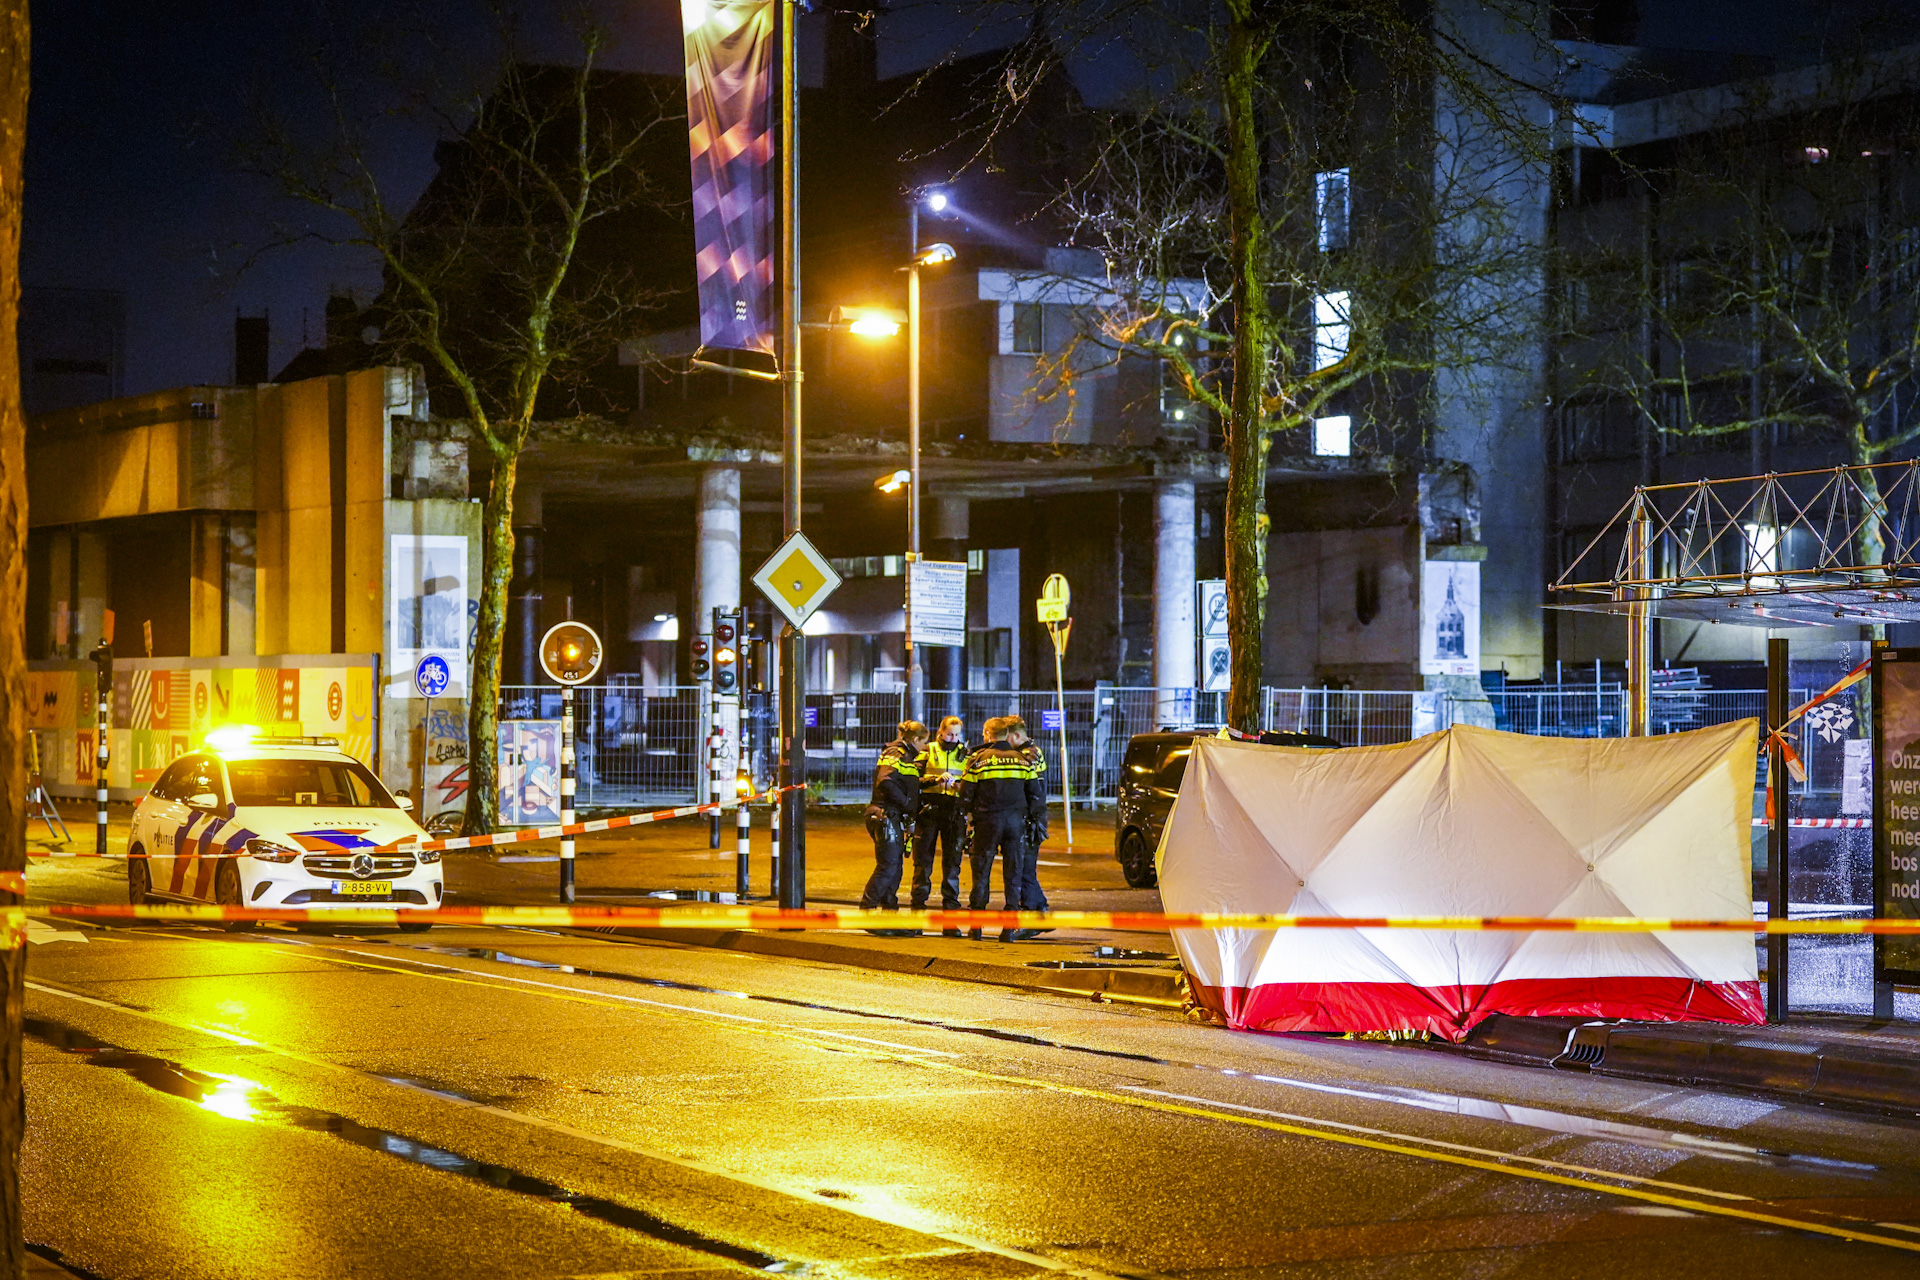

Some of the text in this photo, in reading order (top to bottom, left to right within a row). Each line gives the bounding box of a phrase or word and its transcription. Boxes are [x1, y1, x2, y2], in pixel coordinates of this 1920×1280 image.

[1891, 751, 1920, 769] Onz
[1890, 780, 1920, 795] wer
[1890, 800, 1920, 820] hee
[1891, 850, 1918, 872] bos
[341, 883, 388, 893] P-858-VV
